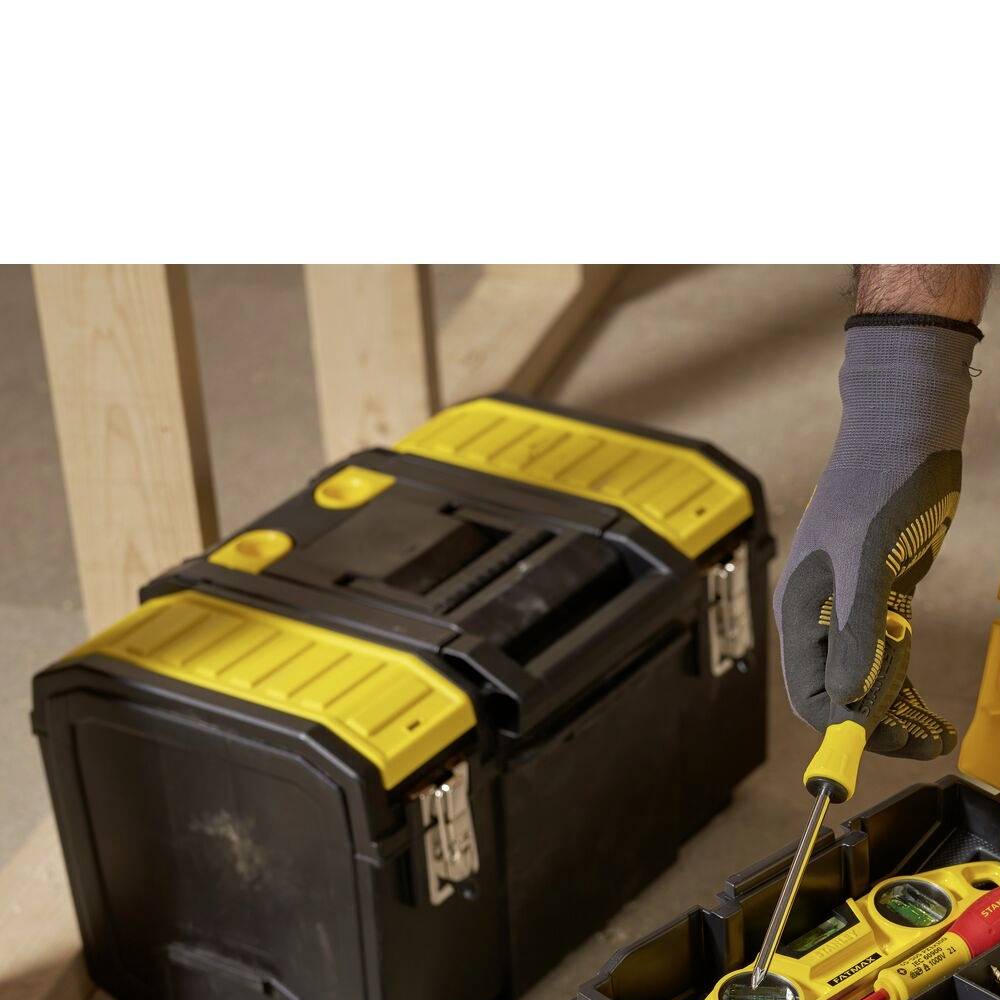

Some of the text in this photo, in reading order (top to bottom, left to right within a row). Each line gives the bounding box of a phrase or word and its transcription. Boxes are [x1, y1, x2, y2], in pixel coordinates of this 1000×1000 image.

[911, 946, 943, 967] IEC 60900
[929, 952, 946, 966] 1000V
[832, 956, 876, 984] FATMAX
